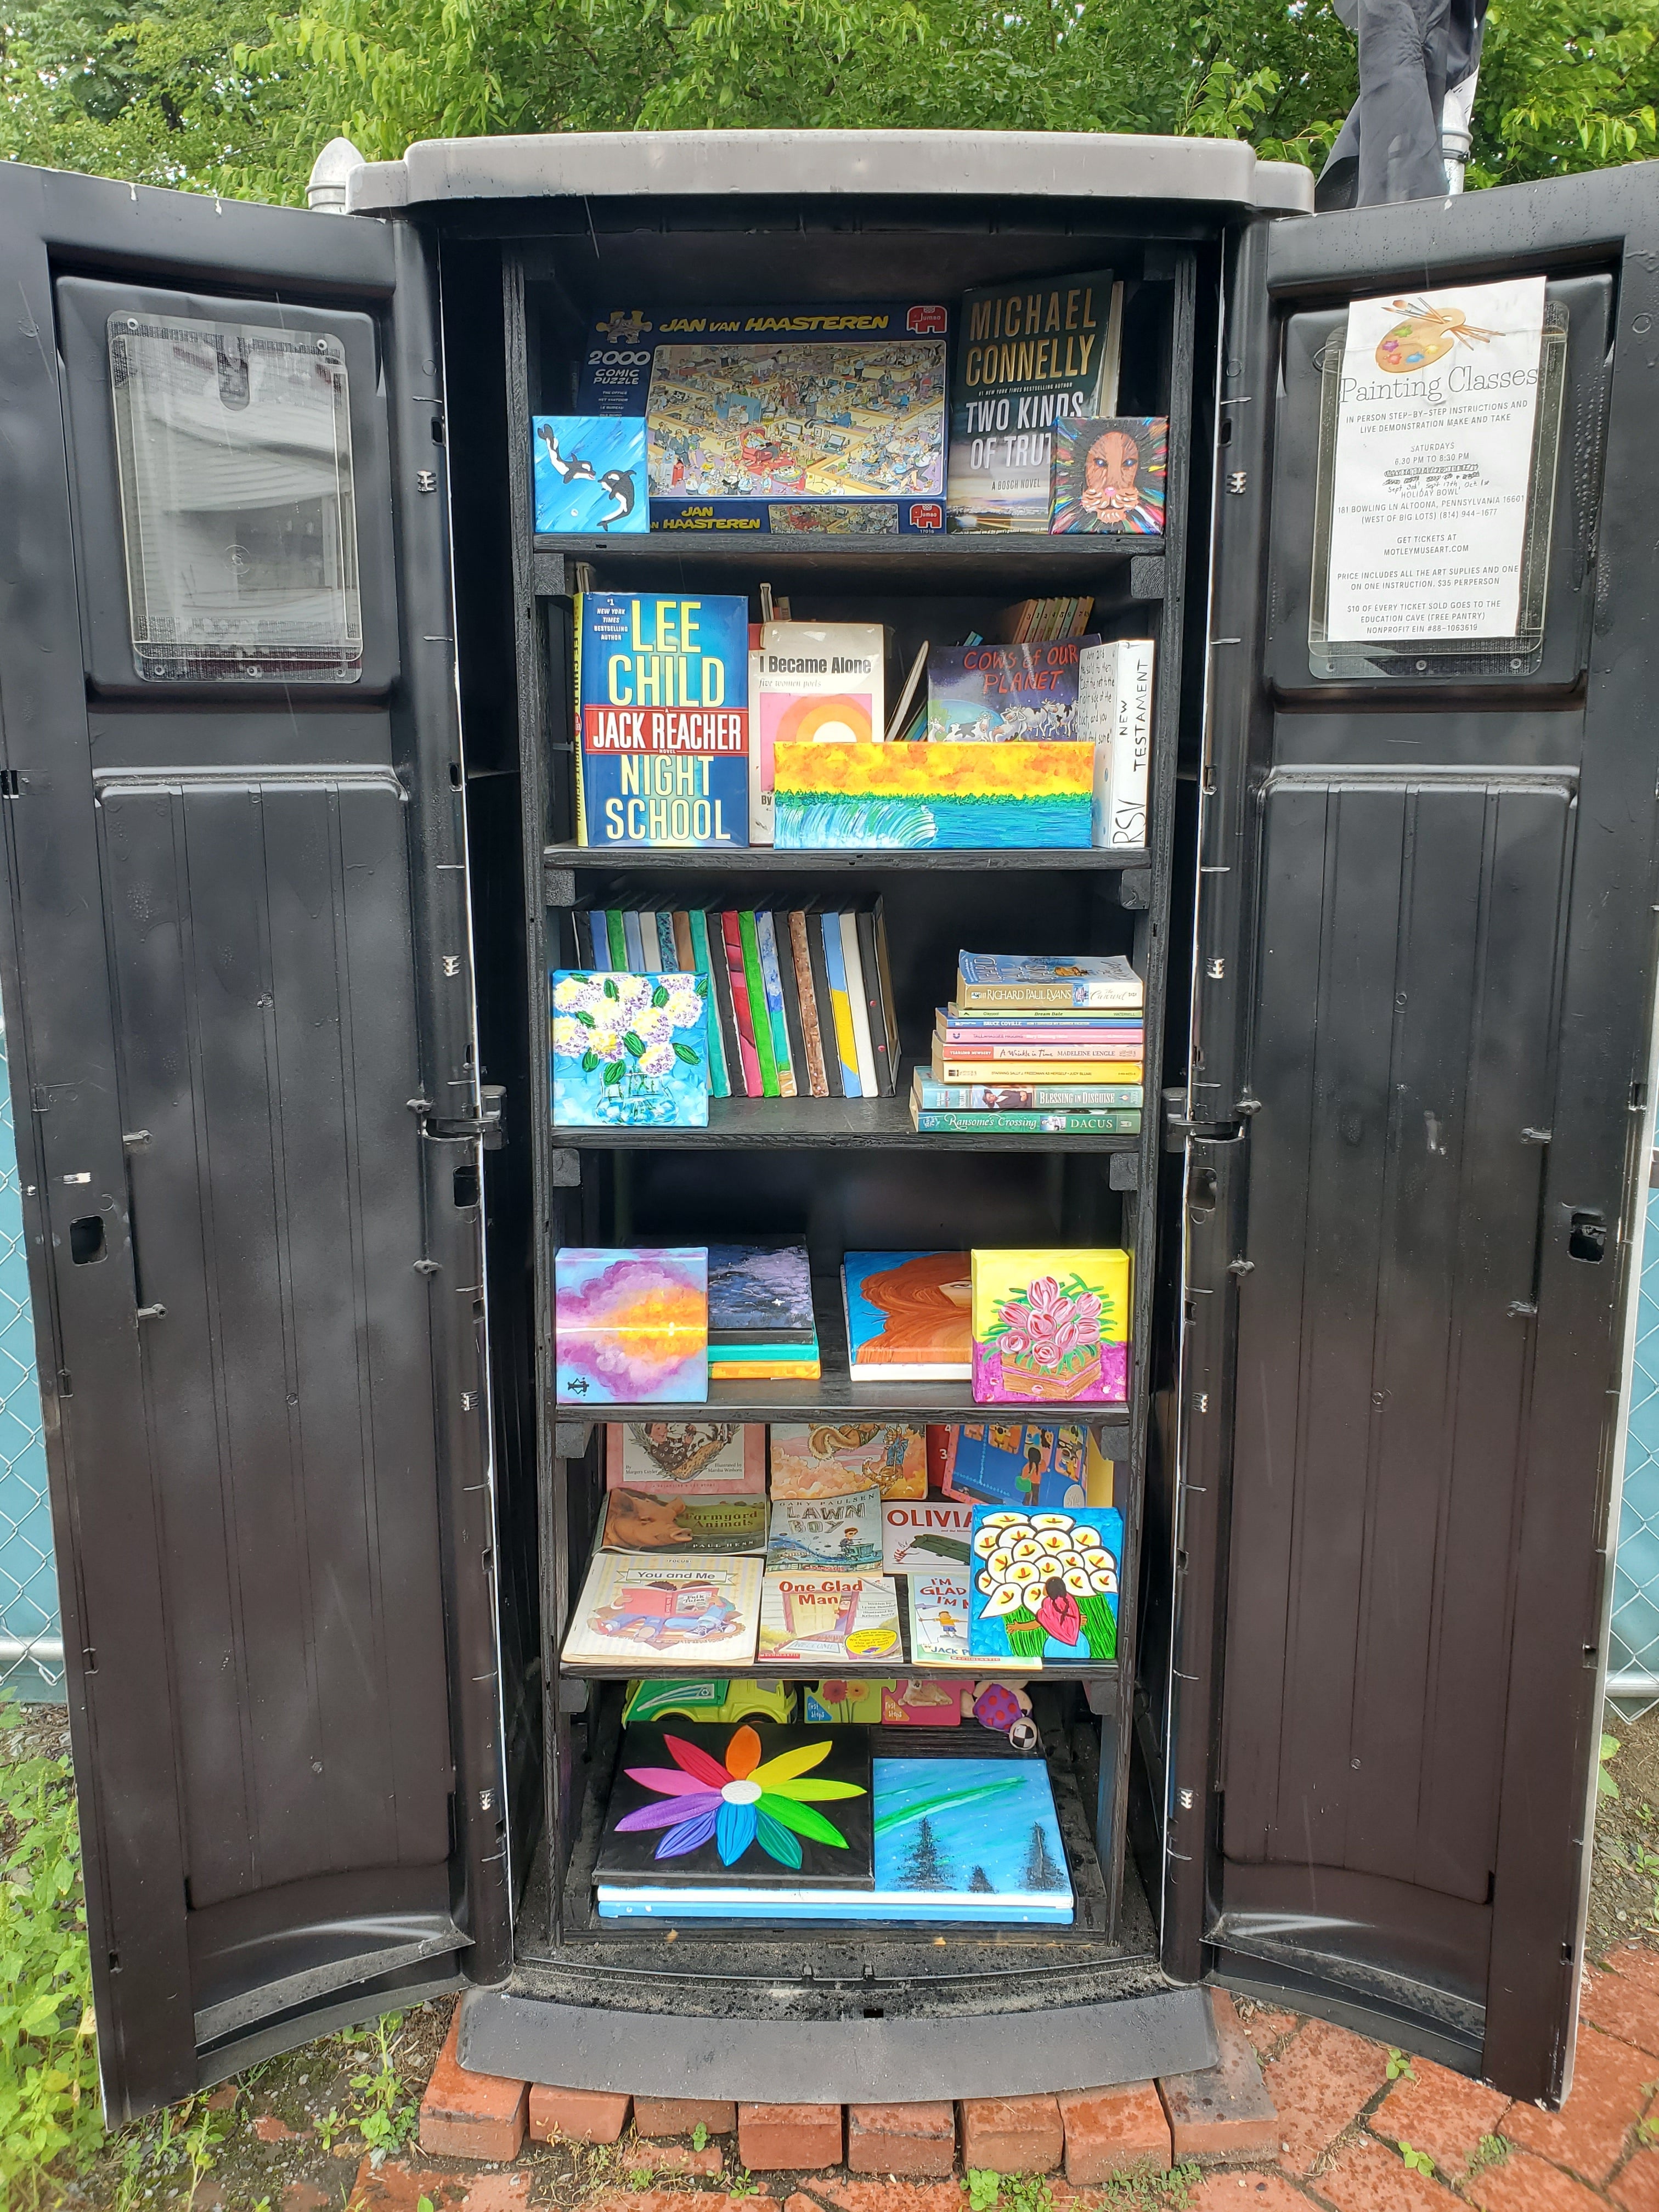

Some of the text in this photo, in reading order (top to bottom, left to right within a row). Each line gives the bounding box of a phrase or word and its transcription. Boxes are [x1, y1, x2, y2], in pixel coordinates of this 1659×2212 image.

[969, 287, 1096, 341] MICHAEL
[659, 318, 707, 332] JAN
[744, 315, 889, 331] HAASTEREN
[588, 351, 651, 365] 2000
[966, 334, 1095, 386] CONNELLY
[595, 369, 640, 377] COMIC
[1340, 366, 1538, 402] Painting Classes
[966, 391, 1084, 433] TWO KINDS
[1357, 413, 1386, 422] PERSON
[1389, 408, 1447, 420] STEP-BY-STEP
[1449, 402, 1508, 414] INSTRUCTIONS
[1510, 400, 1527, 409] AND
[1379, 420, 1444, 432] DEMONSTRATION
[1491, 414, 1511, 422] TAKE
[970, 432, 1051, 470] OF TRUT
[1410, 442, 1454, 452] SATURDAYS
[991, 478, 1040, 490] A BOSCH NOVEL
[1401, 489, 1434, 498] HOLIDAY
[1351, 504, 1386, 512] BOWLING
[1401, 501, 1438, 509] ALTOONA,
[1442, 496, 1500, 507] PENNSYLVANIA
[1503, 495, 1524, 503] 16601
[681, 506, 713, 517] JAN
[1362, 516, 1384, 524] (WEST
[1440, 511, 1458, 519] (814)
[1462, 509, 1497, 517] 944-1677
[663, 518, 760, 529] HAASTEREN
[1414, 534, 1444, 543] TICKETS
[1384, 545, 1469, 555] MOTLEYMUSEART.COM
[1361, 571, 1398, 579] INCLUDES
[1449, 567, 1480, 575] SUPLIES
[1383, 580, 1435, 589] INSTRUCTION.
[1361, 614, 1403, 623] EDUCATION
[631, 600, 702, 653] LEE
[963, 651, 1016, 670] COWS
[1047, 644, 1078, 665] OUR
[760, 656, 871, 674] I Became Alone
[608, 654, 725, 707] CHILD
[759, 678, 772, 688] five
[803, 679, 821, 688] poets
[983, 670, 1064, 695] PLANET
[1119, 700, 1128, 736] NEW
[1133, 658, 1148, 772] TESTAMENT
[593, 712, 741, 750] JACK REACHER
[621, 754, 714, 796] NIGHT
[761, 795, 772, 805] By
[606, 798, 731, 840] SCHOOL
[1113, 799, 1146, 844] RSV
[987, 989, 1071, 1001] RICHARD PAUL EVANS
[1000, 1049, 1006, 1057] A
[1039, 1049, 1053, 1057] Time
[1040, 1092, 1073, 1104] BLESSING
[1082, 1092, 1115, 1104] DISGUISE
[944, 1113, 994, 1130] Ransome's
[989, 1114, 1037, 1129] Crossing
[1071, 1119, 1113, 1128] DACUS
[939, 1448, 947, 1459] 3
[820, 1493, 874, 1505] PAULSEN
[686, 1511, 758, 1521] Farmyard
[787, 1503, 865, 1520] LAWN
[693, 1520, 753, 1528] Animals
[788, 1520, 844, 1534] BOY
[779, 1580, 815, 1592] One
[821, 1580, 863, 1592] Glad
[920, 1586, 967, 1595] GLAD
[798, 1594, 838, 1605] Man
[937, 1596, 957, 1606] I'M
[811, 1711, 825, 1720] steps
[888, 1711, 902, 1720] steps
